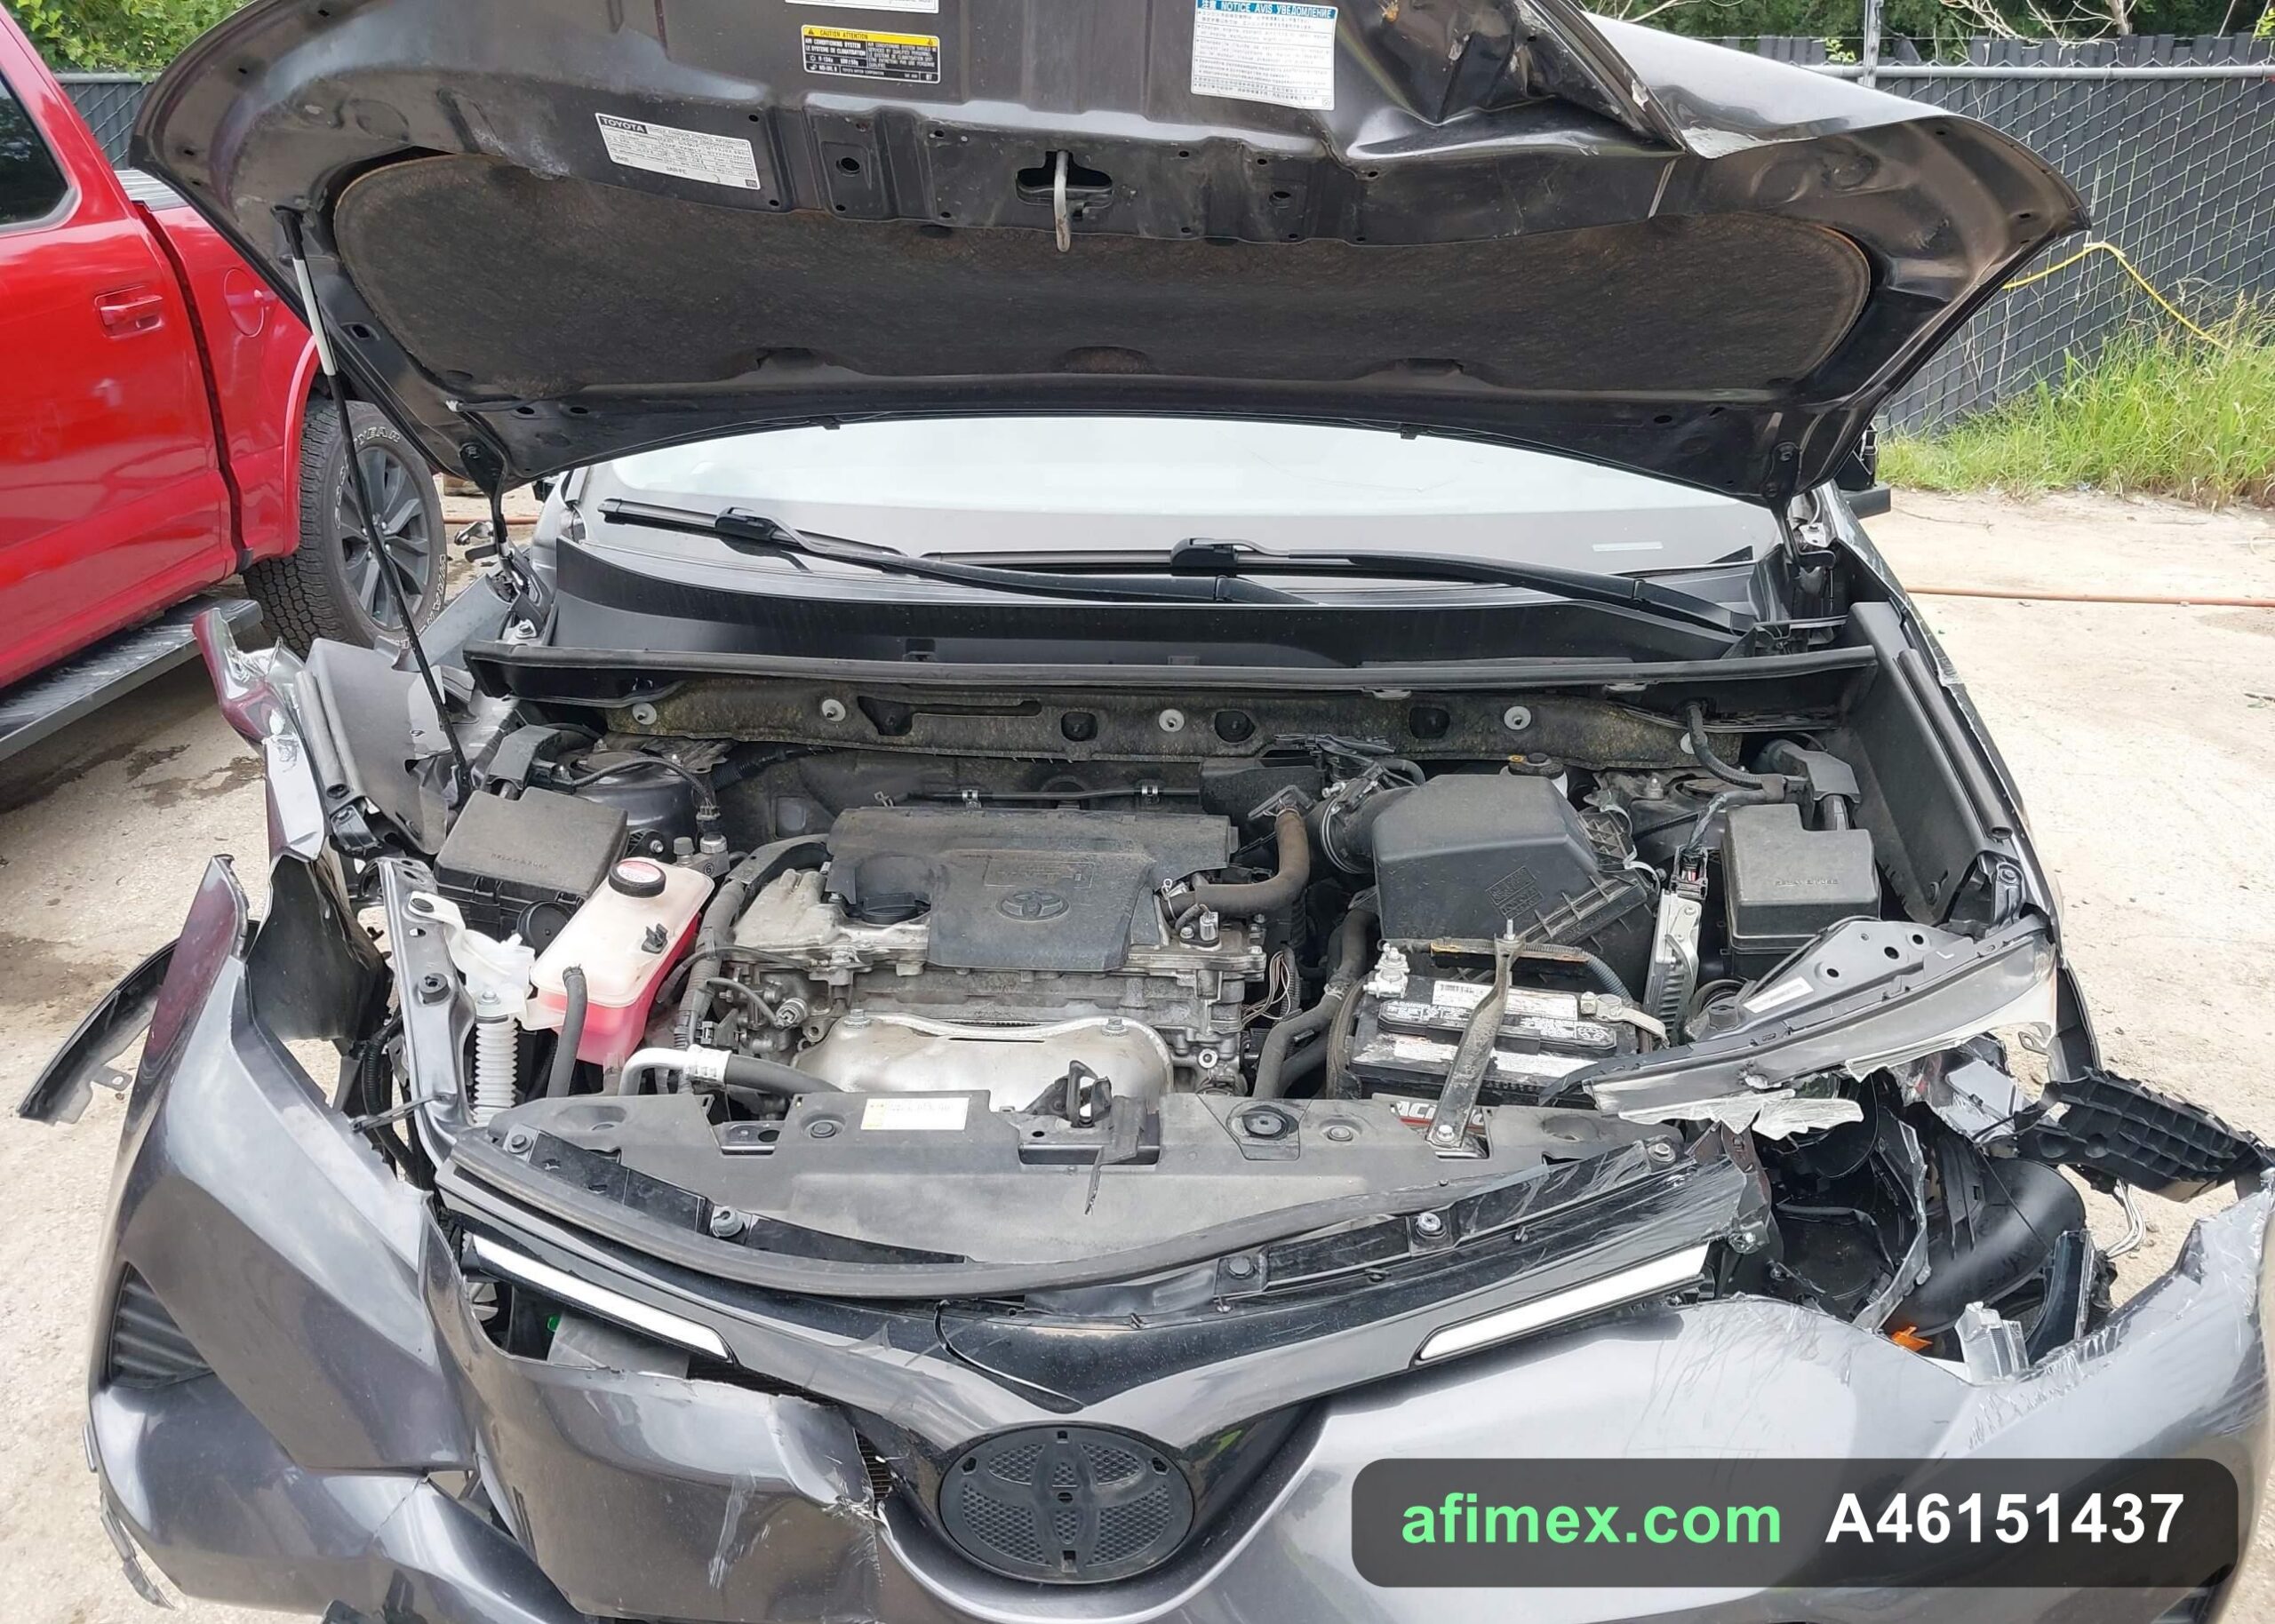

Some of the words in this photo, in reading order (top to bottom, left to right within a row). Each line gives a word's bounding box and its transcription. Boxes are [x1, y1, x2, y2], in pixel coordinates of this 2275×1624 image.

[1221, 2, 1250, 12] NOTICE
[1255, 4, 1273, 14] AVIS
[1277, 5, 1332, 19] УВЕДОМЛЕНИЕ
[601, 117, 645, 132] TOYOTA
